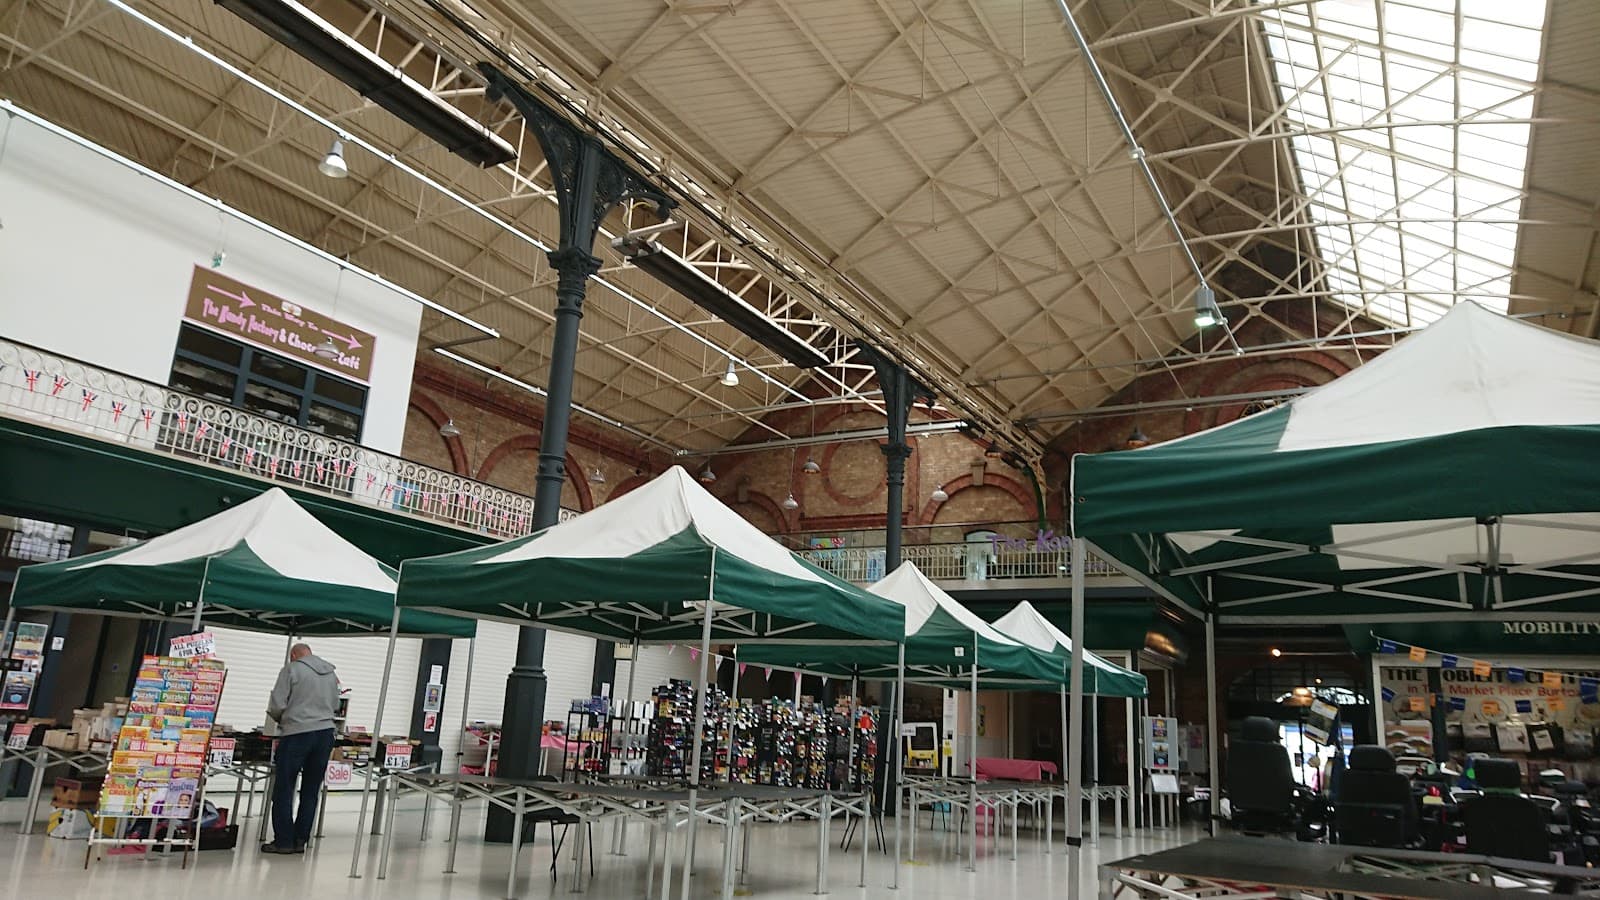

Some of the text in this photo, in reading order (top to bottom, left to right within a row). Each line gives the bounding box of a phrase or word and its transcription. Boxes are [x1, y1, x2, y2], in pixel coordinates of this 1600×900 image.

[279, 328, 287, 343] &
[1449, 684, 1495, 695] Market
[1499, 685, 1532, 696] Place
[1538, 686, 1580, 697] Burto
[328, 766, 349, 780] Sale
